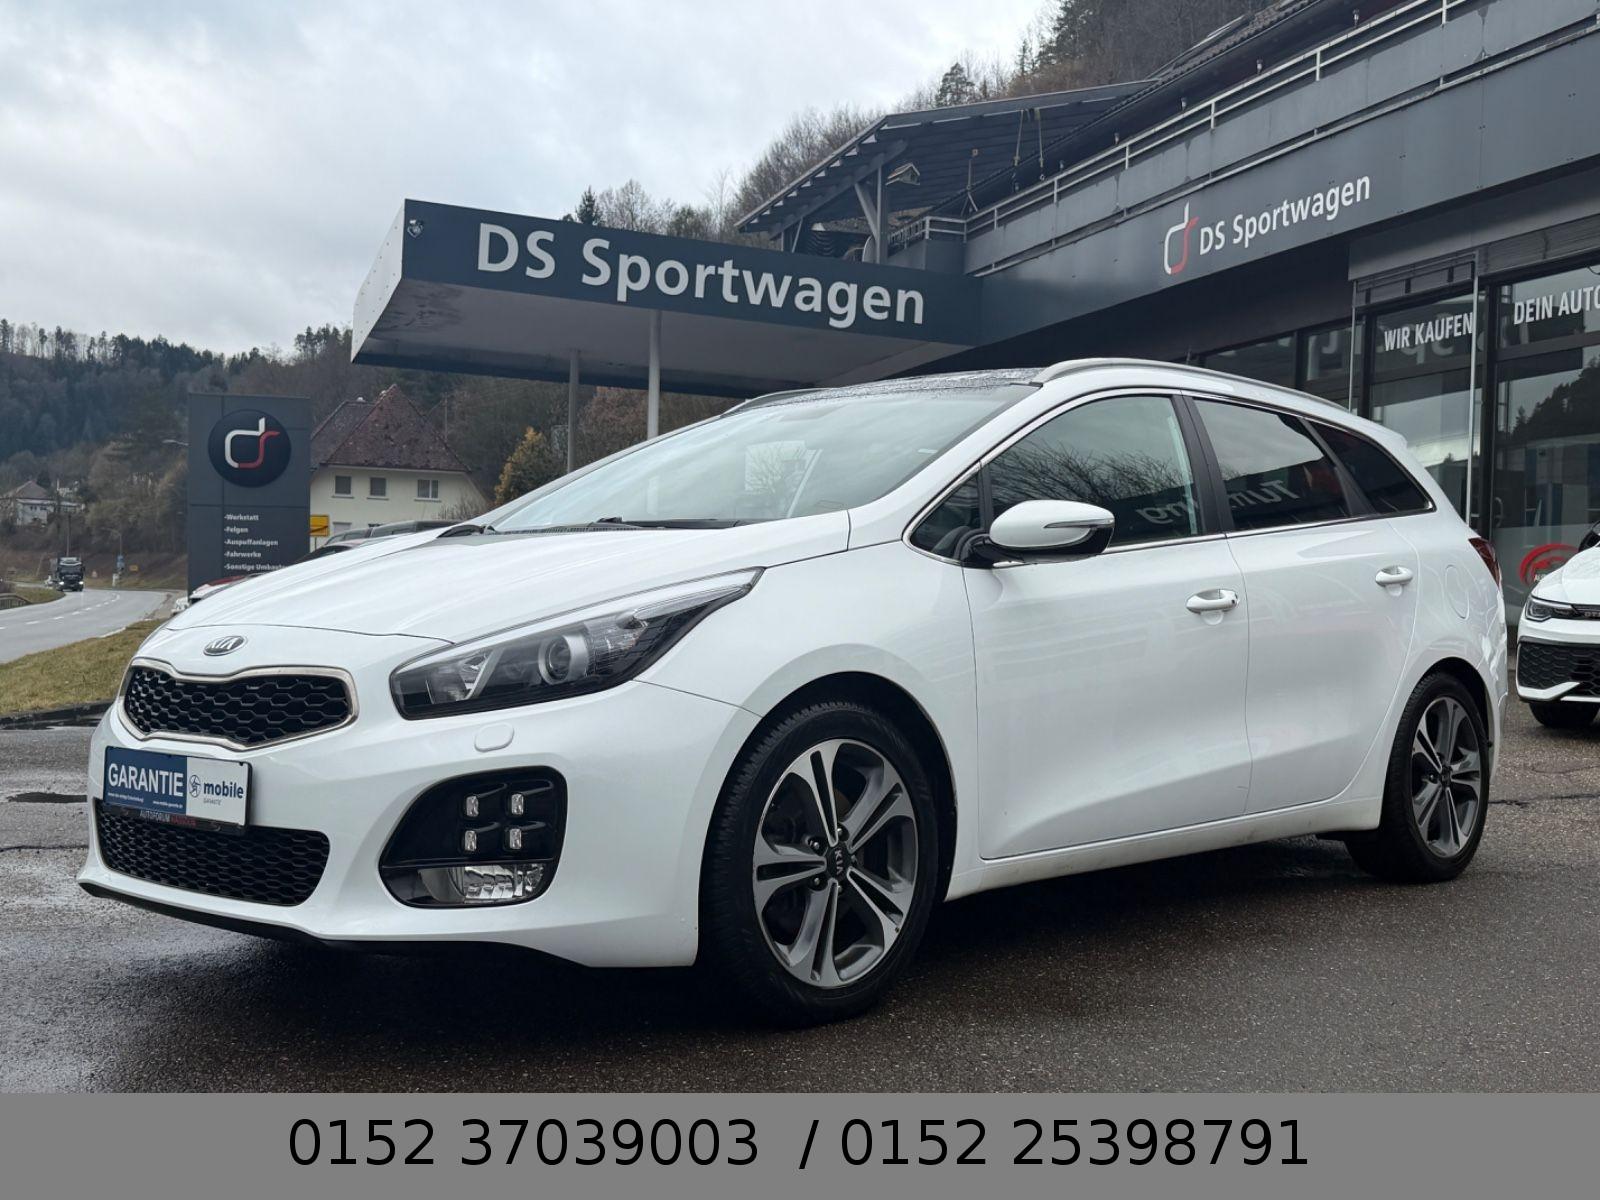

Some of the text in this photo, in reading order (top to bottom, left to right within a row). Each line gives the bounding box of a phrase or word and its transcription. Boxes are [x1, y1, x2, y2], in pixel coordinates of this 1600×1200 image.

[1200, 175, 1370, 256] DS Sportwagen
[477, 221, 925, 330] DS Sportwagen
[1384, 325, 1410, 351] WIR
[1414, 311, 1473, 345] KAUFEN
[1513, 294, 1552, 325] DEIN
[1558, 284, 1600, 316] AUTO
[107, 762, 184, 798] GARANTIE
[203, 781, 244, 801] mobile
[834, 850, 844, 876] KIA
